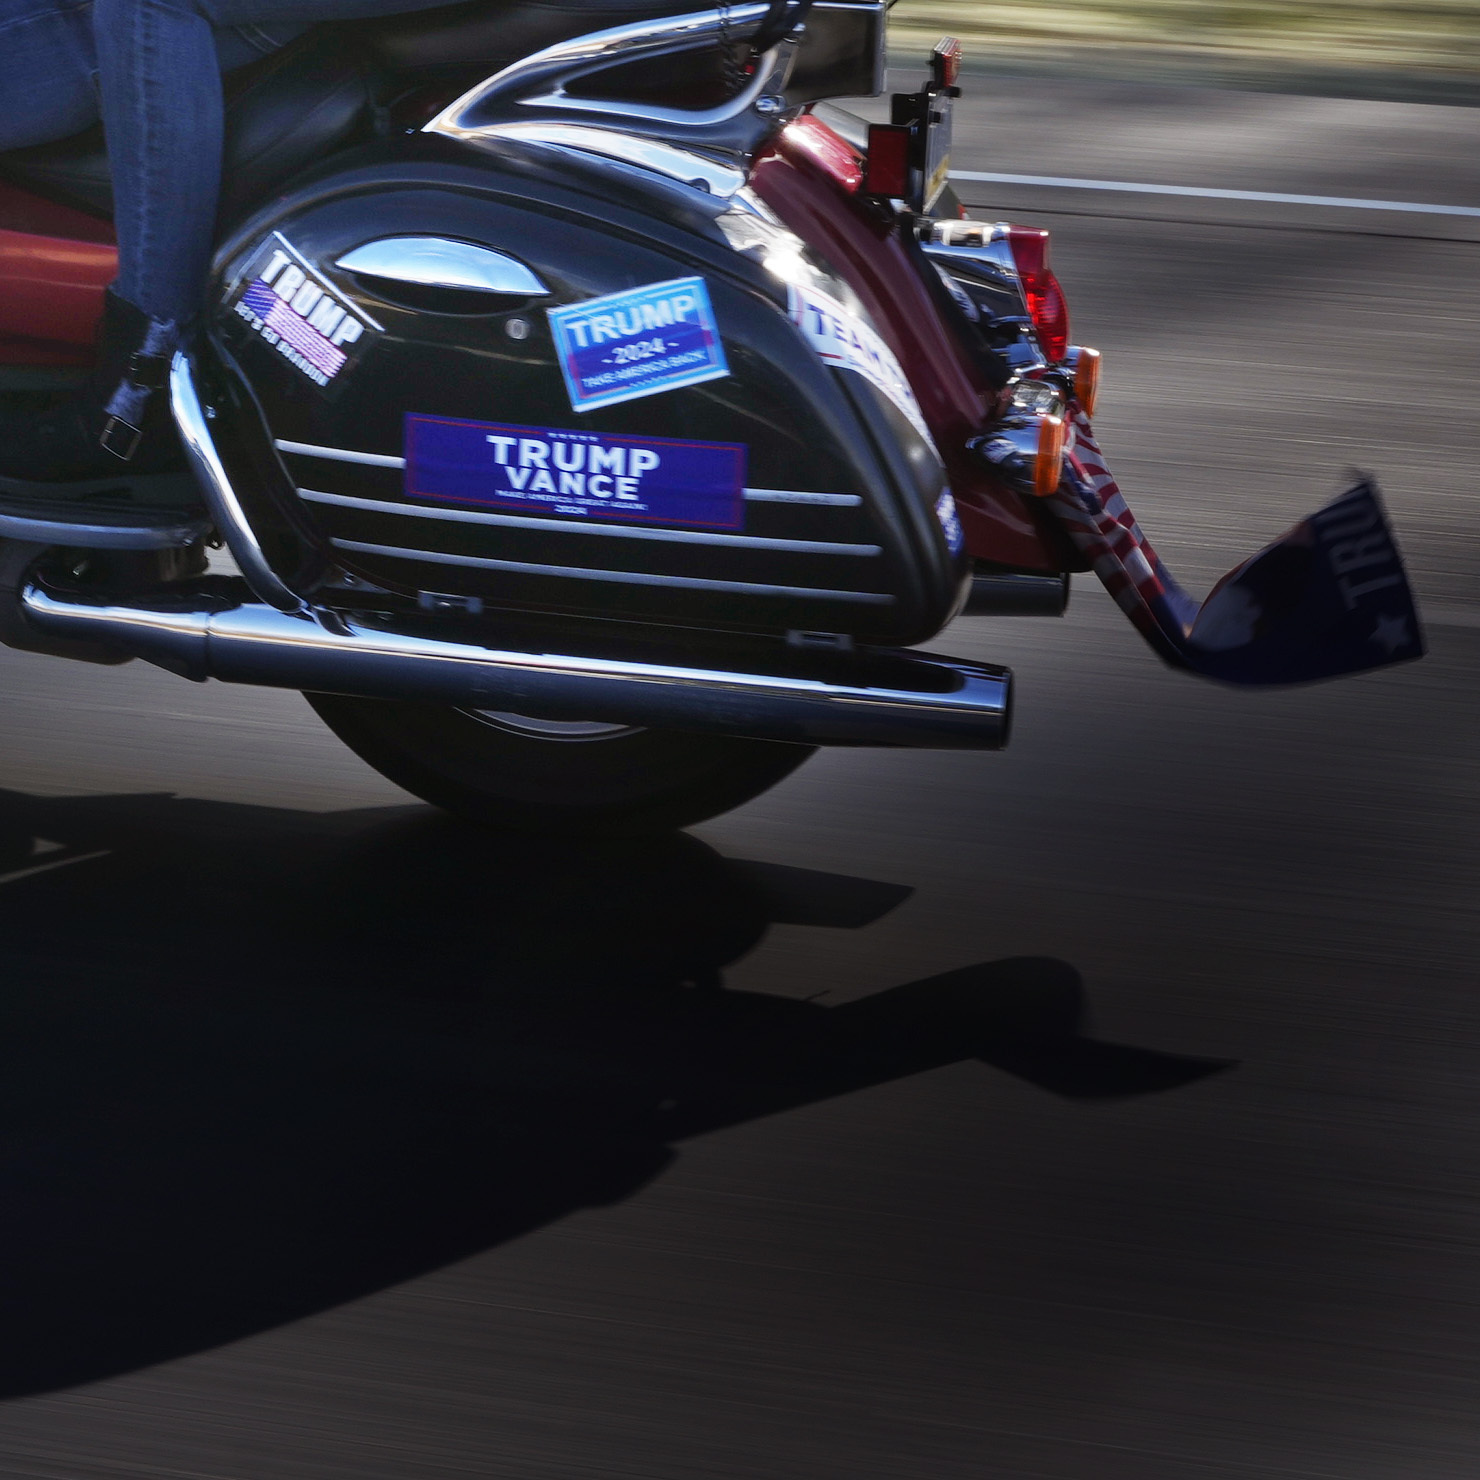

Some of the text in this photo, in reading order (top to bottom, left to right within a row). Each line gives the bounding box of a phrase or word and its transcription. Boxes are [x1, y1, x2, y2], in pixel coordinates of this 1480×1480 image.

[260, 249, 365, 346] TRUMP
[566, 295, 696, 347] TRUMP
[486, 434, 661, 478] TRUMP
[504, 466, 641, 501] VANCE
